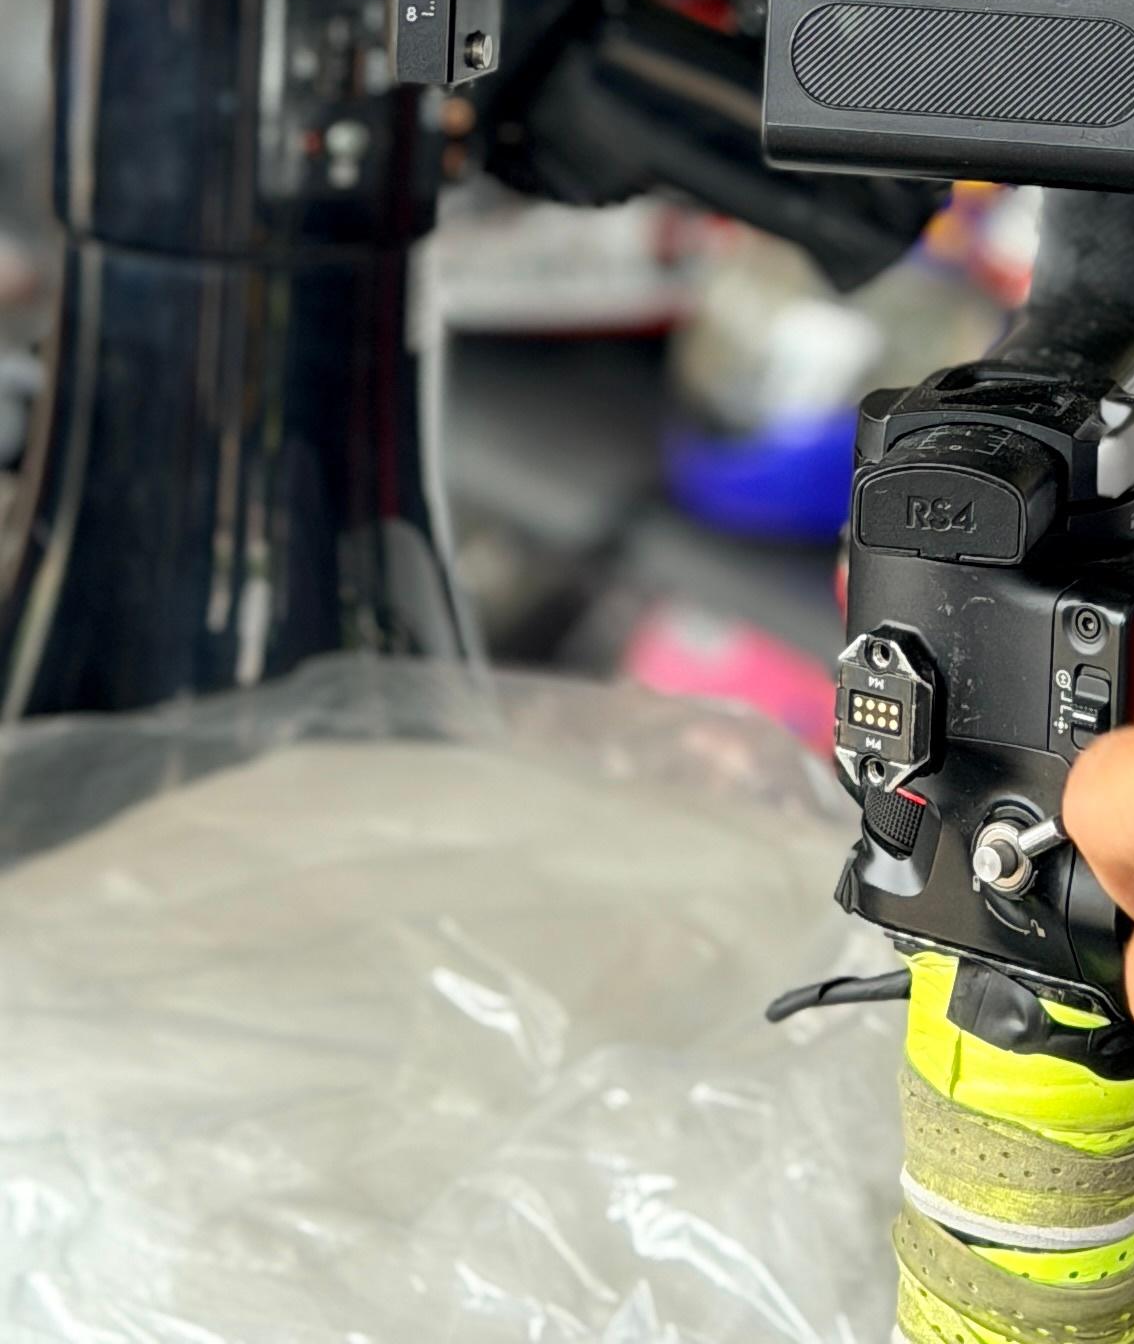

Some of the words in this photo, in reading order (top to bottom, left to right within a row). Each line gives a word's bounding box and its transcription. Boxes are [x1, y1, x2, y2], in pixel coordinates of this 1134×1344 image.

[406, 6, 418, 22] 8
[905, 495, 977, 534] RS4
[865, 736, 882, 751] M4
